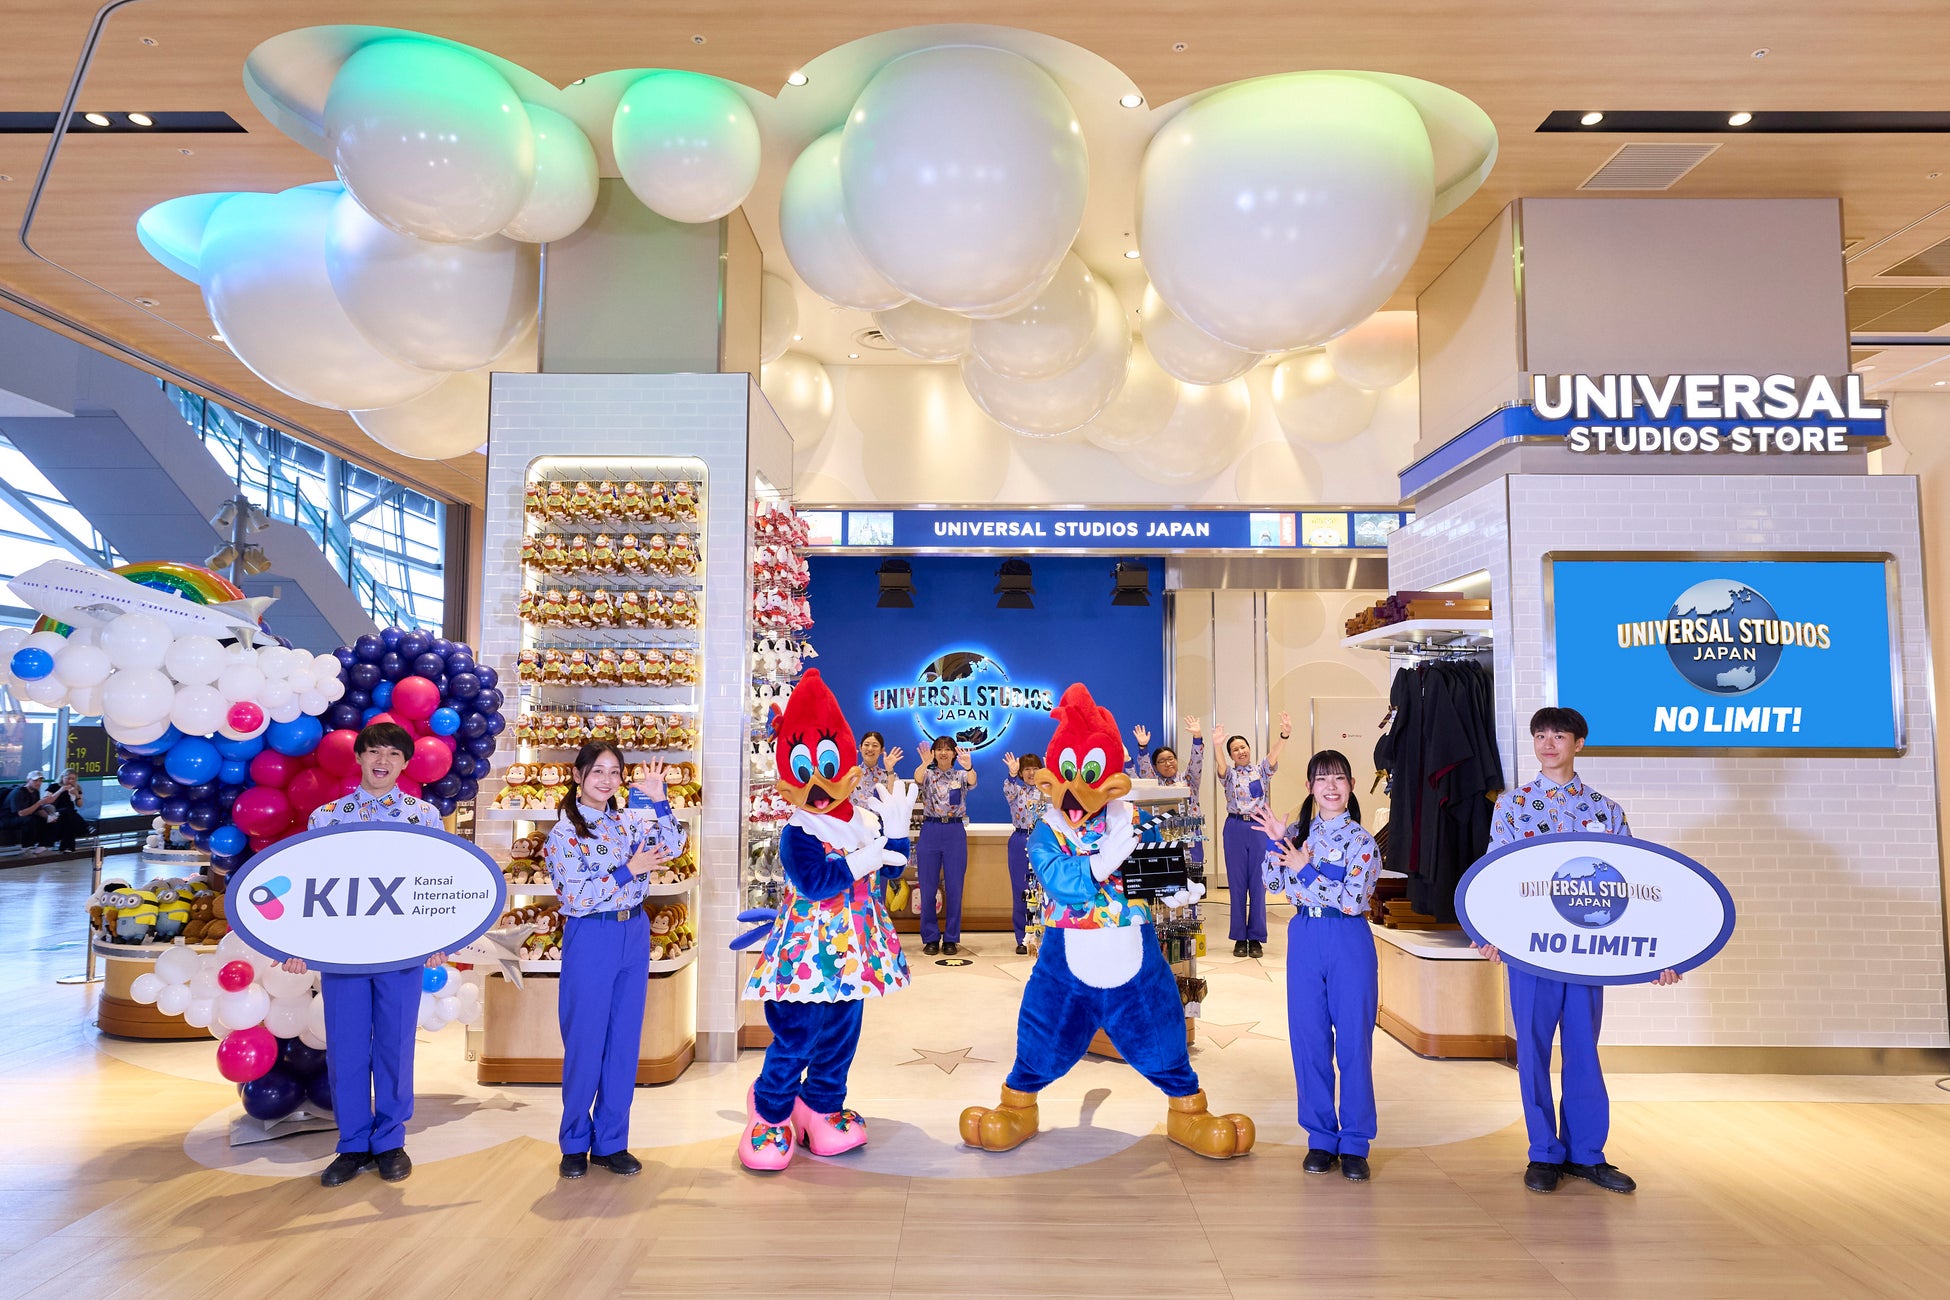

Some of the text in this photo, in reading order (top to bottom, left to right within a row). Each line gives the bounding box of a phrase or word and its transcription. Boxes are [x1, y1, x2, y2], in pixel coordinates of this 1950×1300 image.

[1533, 374, 1883, 420] UNIVERSAL
[1570, 426, 1849, 452] STUDIOS STORE
[934, 521, 1210, 537] UNIVERSAL STUDIOS JAPAN
[1617, 617, 1832, 650] UNIVERSAL STUDIOS
[1693, 646, 1757, 661] JAPAN
[873, 685, 1055, 712] UNIVERSAL STUDIOS
[936, 709, 990, 721] JAPAN
[1653, 706, 1802, 733] NO LIMIT!
[414, 875, 453, 886] Kansai
[1519, 879, 1663, 902] UNIVERSAL STUDIOS
[303, 876, 406, 918] KIX
[413, 889, 489, 901] International
[1568, 897, 1612, 908] JAPAN
[412, 905, 456, 917] Airport
[1529, 932, 1658, 958] NO LIMIT!
